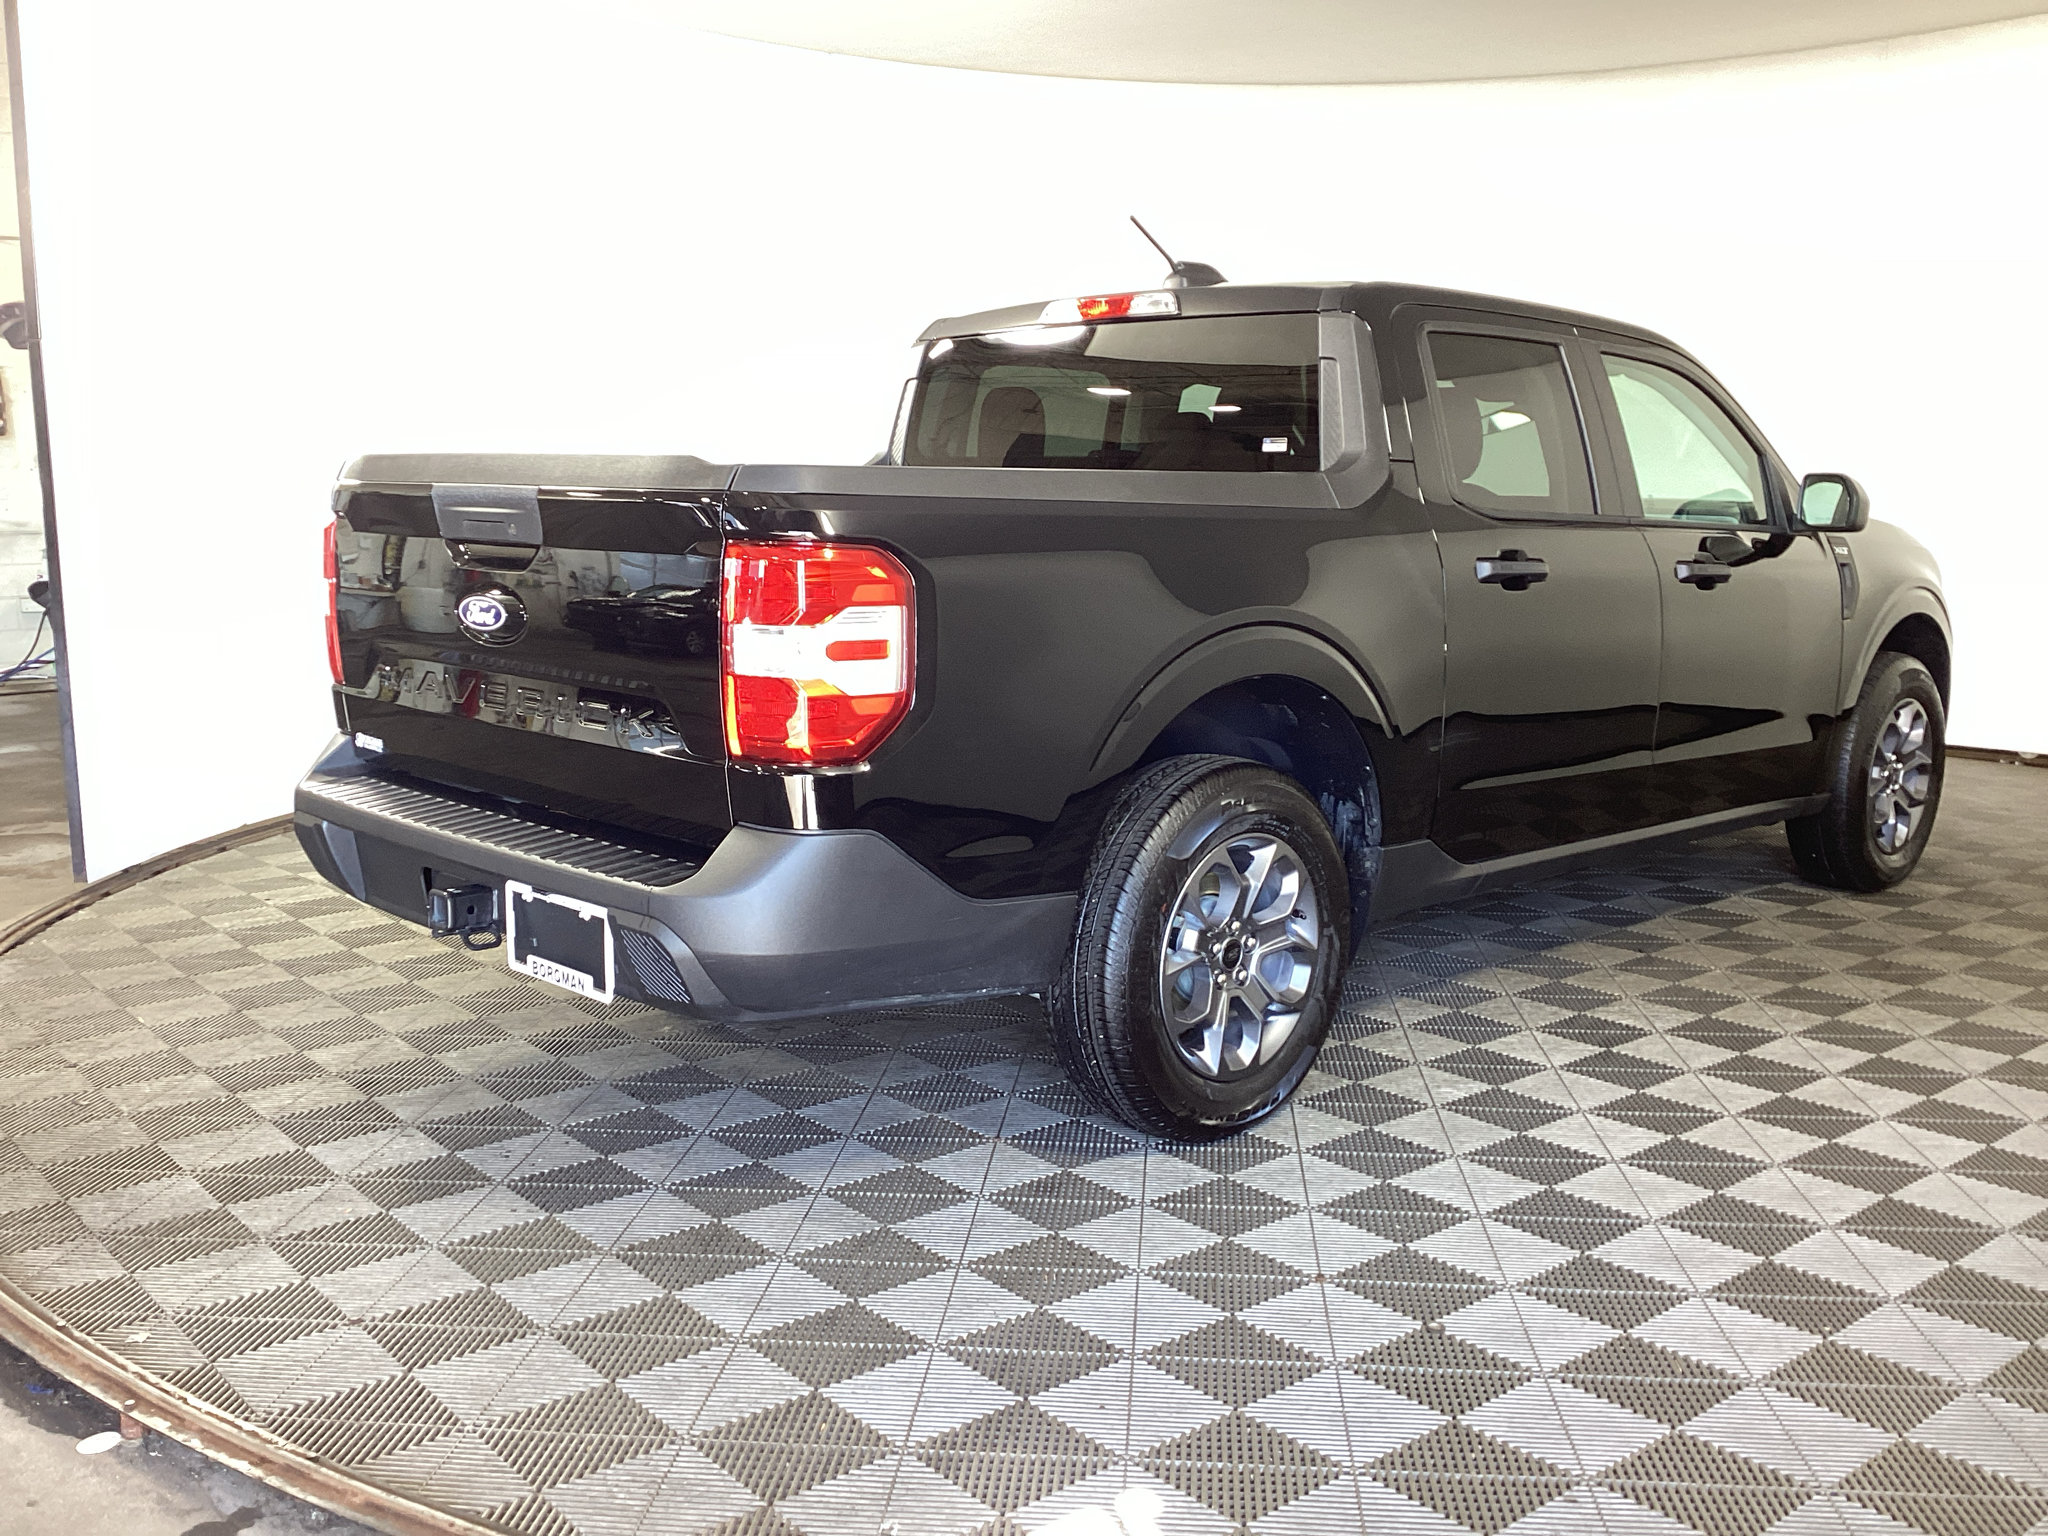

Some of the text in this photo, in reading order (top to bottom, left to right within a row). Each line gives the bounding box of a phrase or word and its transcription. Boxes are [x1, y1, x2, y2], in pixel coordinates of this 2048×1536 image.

[466, 600, 496, 625] Ford
[381, 665, 654, 739] MAVERICK
[532, 960, 585, 992] BORGMAN
